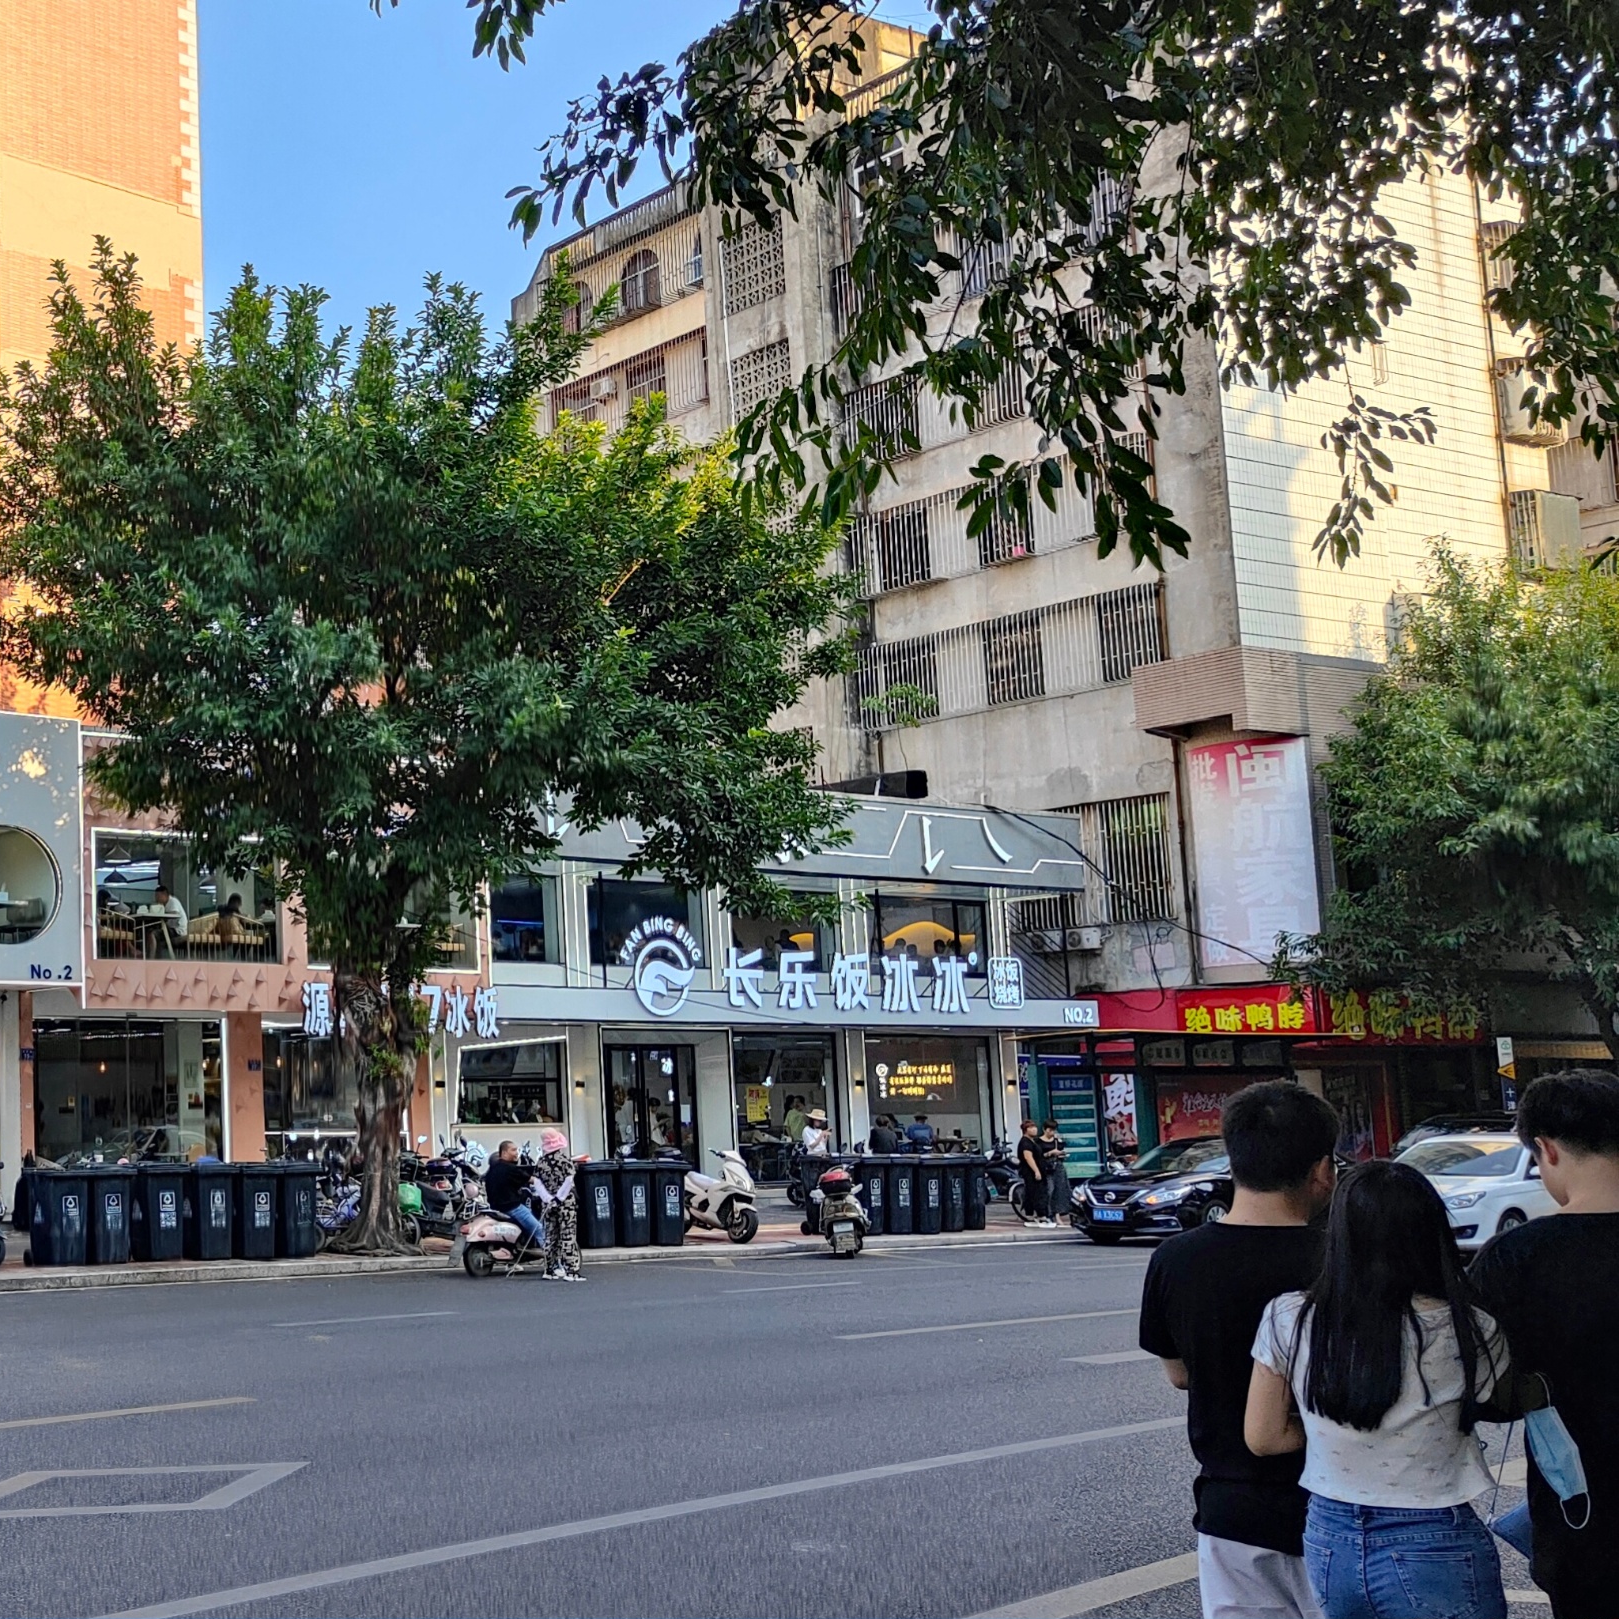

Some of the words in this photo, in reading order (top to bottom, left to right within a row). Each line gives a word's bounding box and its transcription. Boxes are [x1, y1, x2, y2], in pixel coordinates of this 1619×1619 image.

[620, 925, 643, 961] FAN
[643, 916, 674, 934] BING
[675, 927, 702, 962] BING
[30, 964, 73, 981] No.2
[723, 947, 970, 1013] 长乐饭冰冰
[1063, 1007, 1094, 1023] NO.2
[1184, 1001, 1306, 1033] 绝味鸭脖
